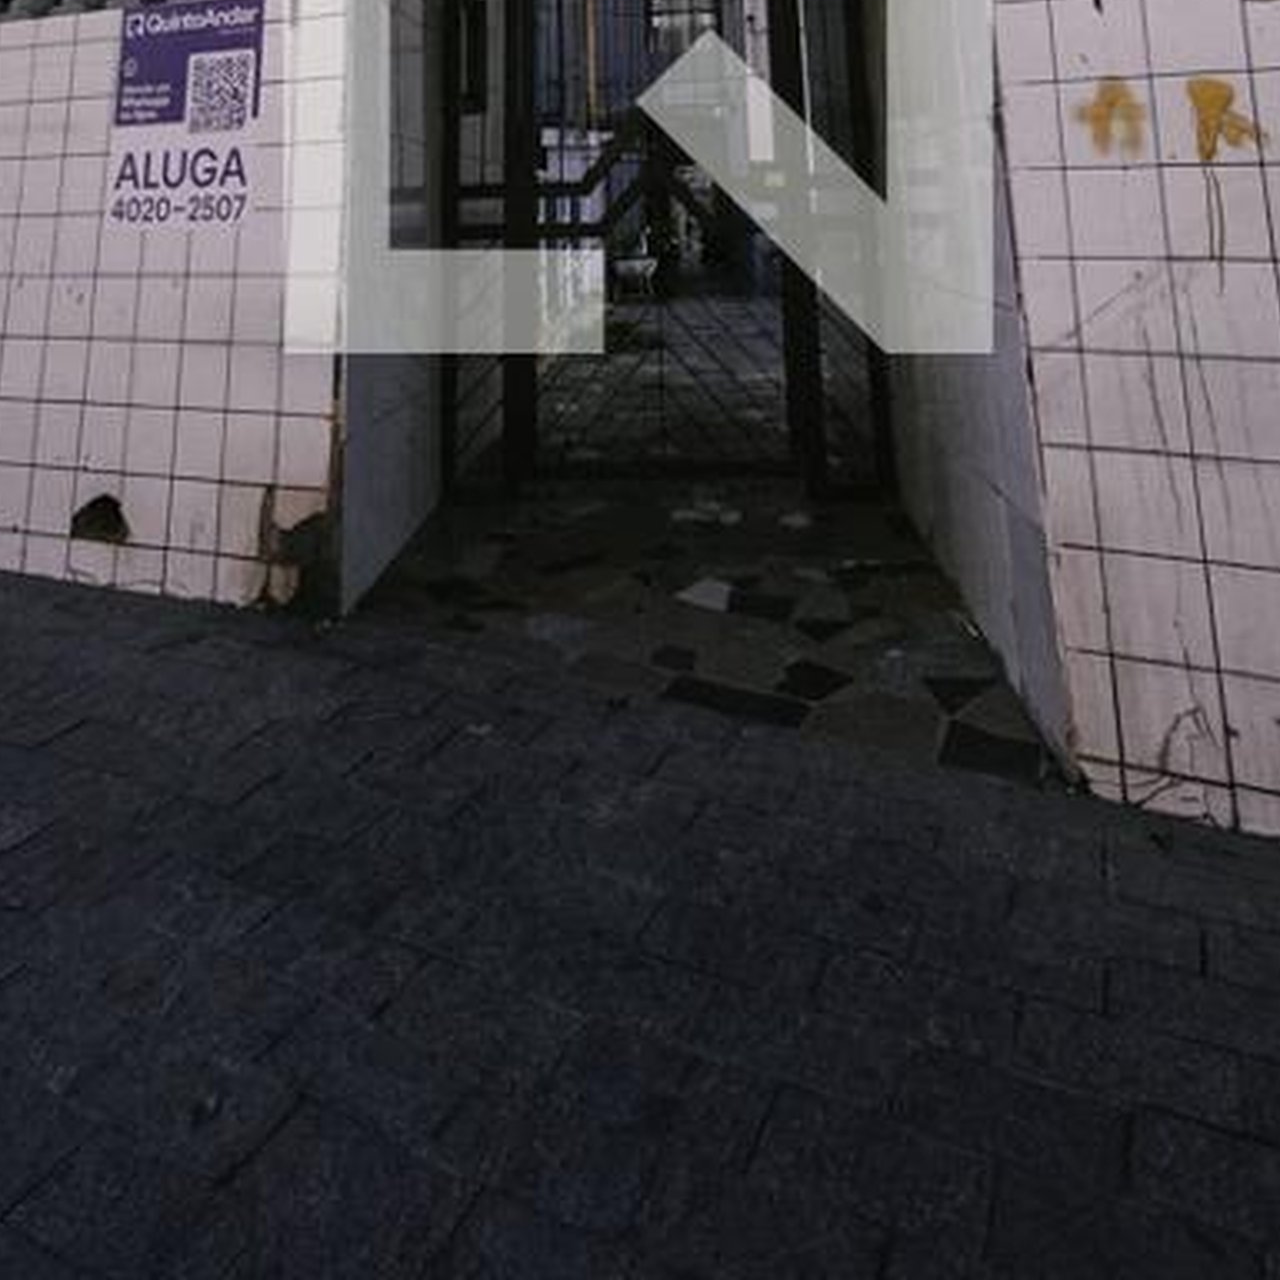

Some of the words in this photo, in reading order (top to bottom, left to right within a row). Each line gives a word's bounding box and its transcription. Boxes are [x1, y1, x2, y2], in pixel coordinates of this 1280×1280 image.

[146, 4, 259, 35] QuintoAndar
[115, 147, 247, 190] ALUGA
[111, 194, 247, 222] 4020-2507
